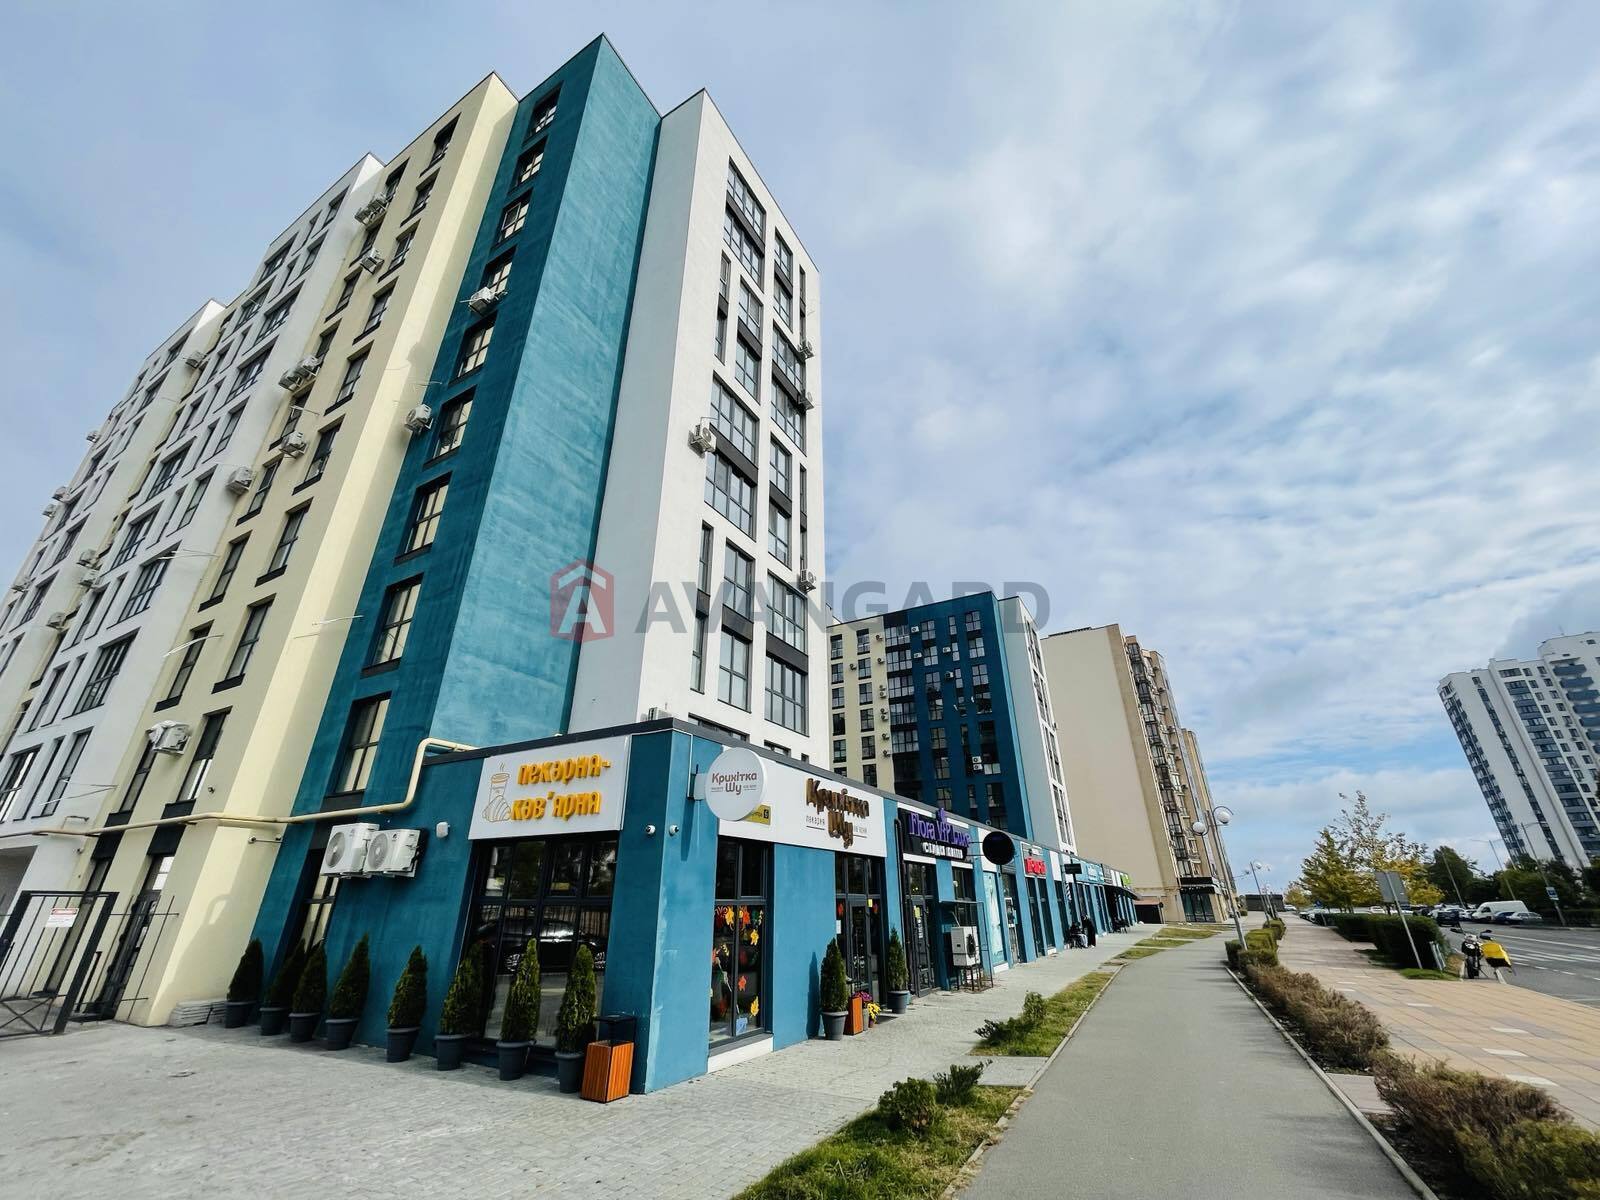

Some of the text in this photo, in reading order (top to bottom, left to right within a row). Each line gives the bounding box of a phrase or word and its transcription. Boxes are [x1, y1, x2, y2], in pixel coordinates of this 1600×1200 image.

[712, 771, 758, 785] Крихітка
[725, 783, 742, 795] Шу
[806, 778, 869, 819] Крихітка
[909, 812, 935, 841] Flora
